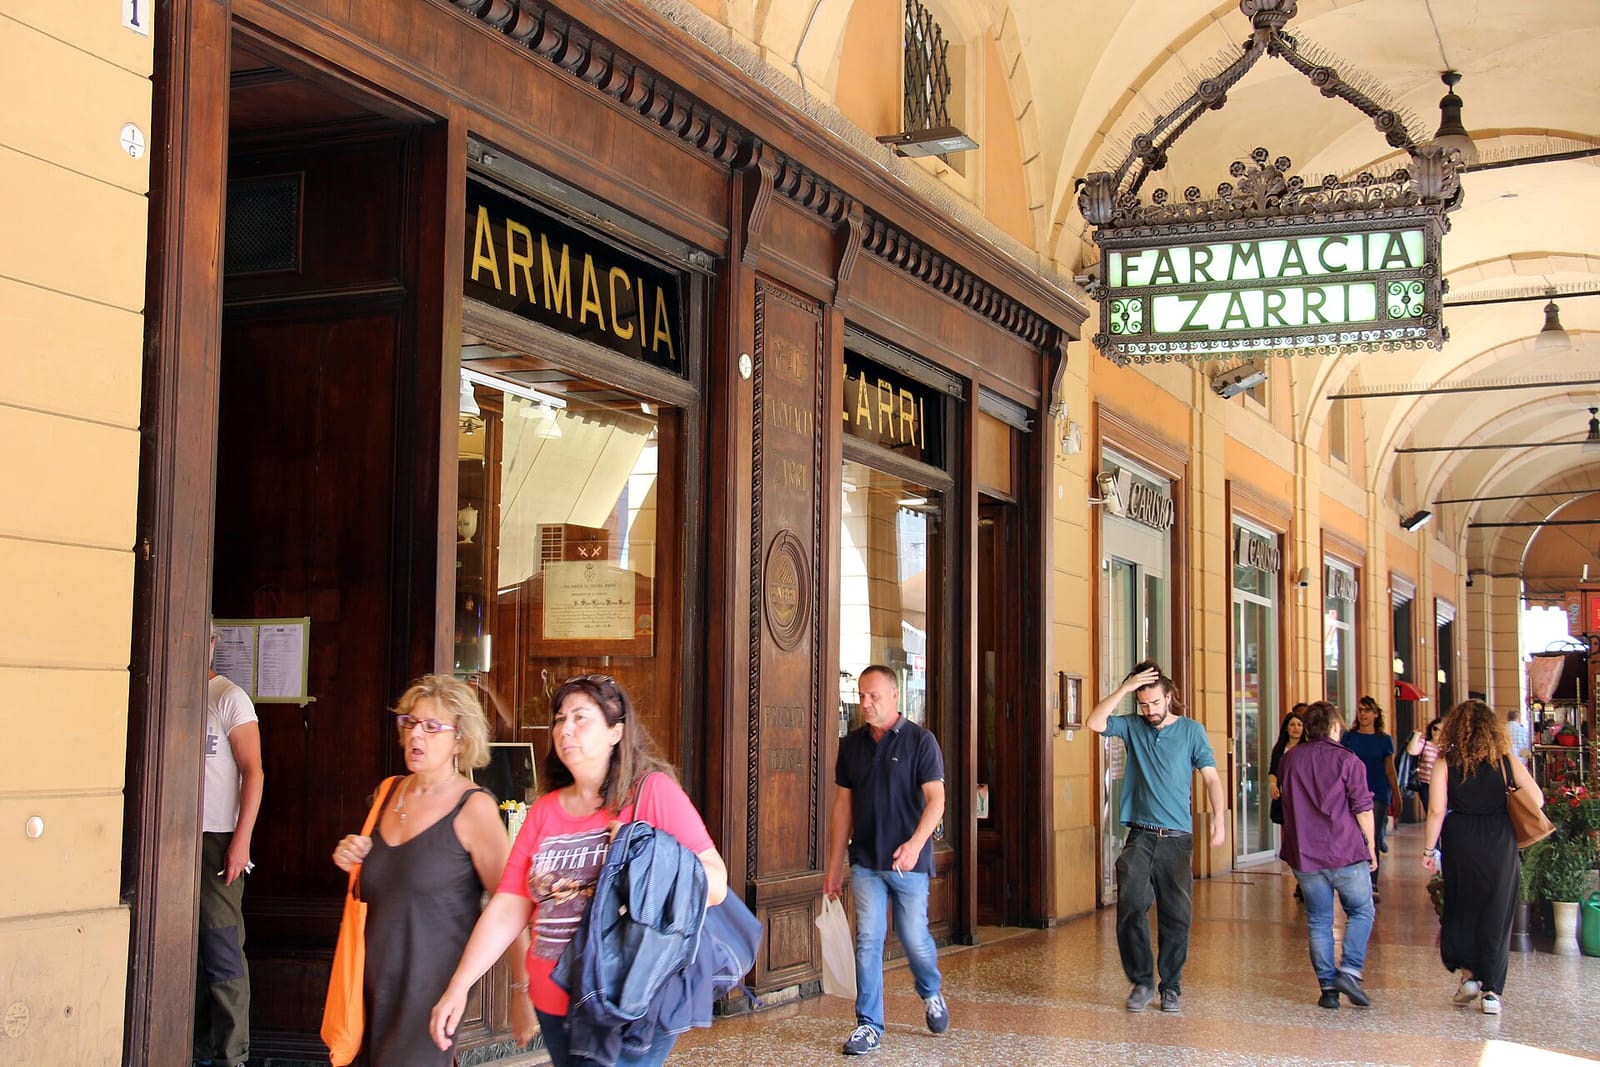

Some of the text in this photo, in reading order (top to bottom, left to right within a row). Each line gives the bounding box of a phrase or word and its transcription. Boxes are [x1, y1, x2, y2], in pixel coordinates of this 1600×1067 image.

[128, 145, 136, 158] G
[1119, 232, 1412, 288] FARMACIA
[1177, 284, 1350, 332] ZARRI
